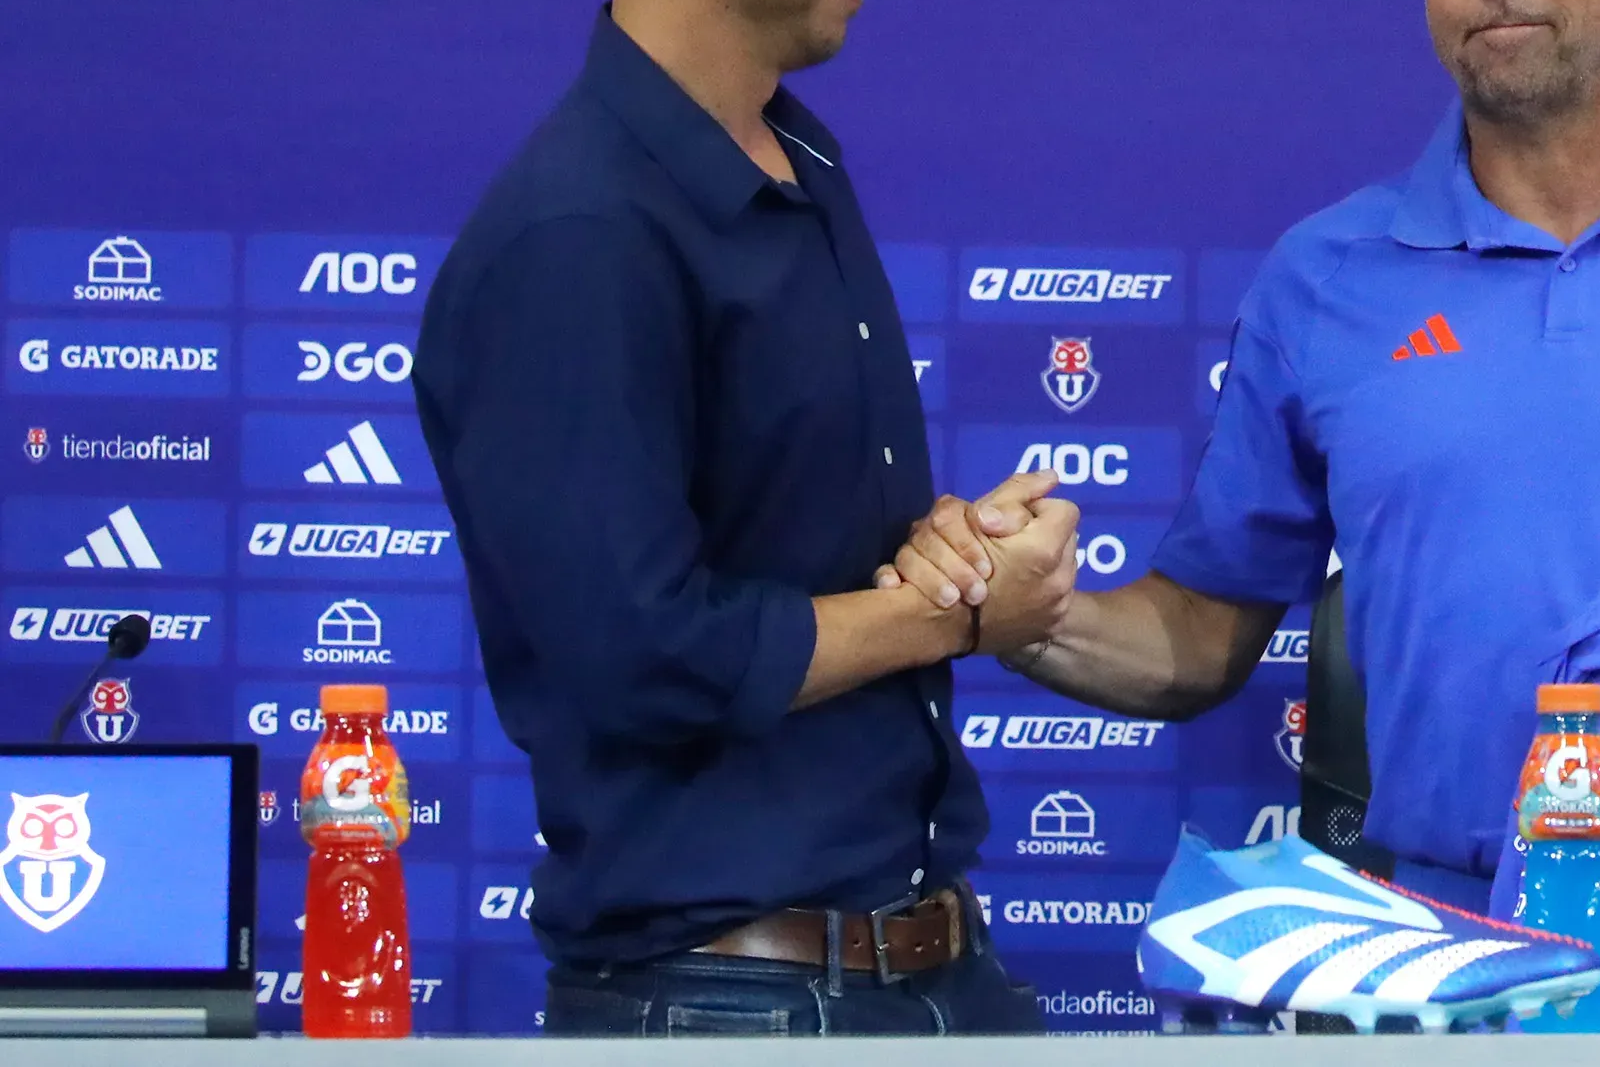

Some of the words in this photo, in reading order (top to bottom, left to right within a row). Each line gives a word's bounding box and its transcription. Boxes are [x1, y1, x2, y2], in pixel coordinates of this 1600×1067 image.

[299, 252, 417, 295] AOC
[73, 285, 162, 301] SODIMAC
[19, 339, 49, 373] G
[60, 345, 218, 371] GATORADE
[1056, 373, 1085, 403] U
[62, 435, 211, 462] tiendaoficial
[49, 609, 211, 642] JUGBET
[302, 648, 393, 664] SODIMAC
[249, 702, 278, 735] G
[290, 708, 448, 734] GAADE
[1016, 839, 1107, 855] SODIMAC
[19, 859, 77, 912] U
